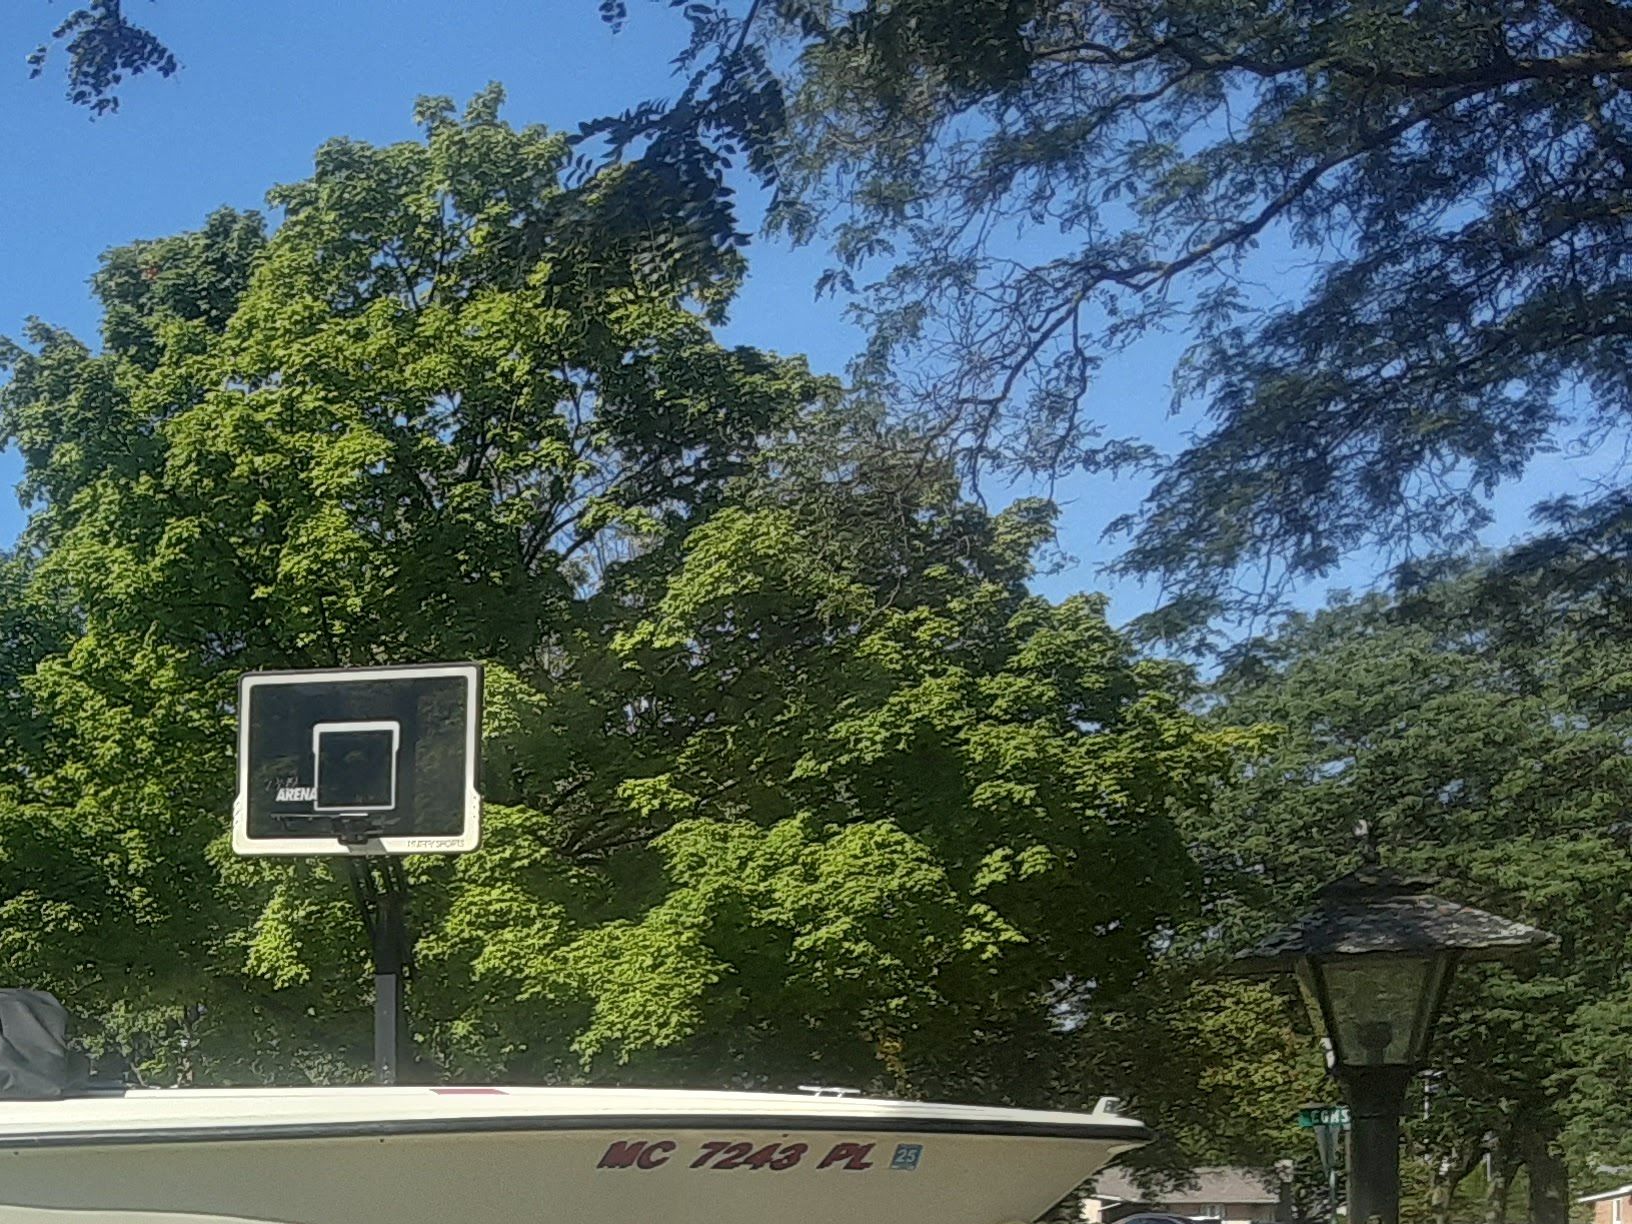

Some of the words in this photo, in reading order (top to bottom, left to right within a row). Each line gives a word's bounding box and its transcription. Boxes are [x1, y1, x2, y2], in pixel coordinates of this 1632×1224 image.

[275, 786, 318, 802] ARENA
[597, 1140, 676, 1170] MC
[689, 1141, 808, 1171] 7243
[816, 1142, 877, 1171] PL
[895, 1148, 918, 1164] 25
